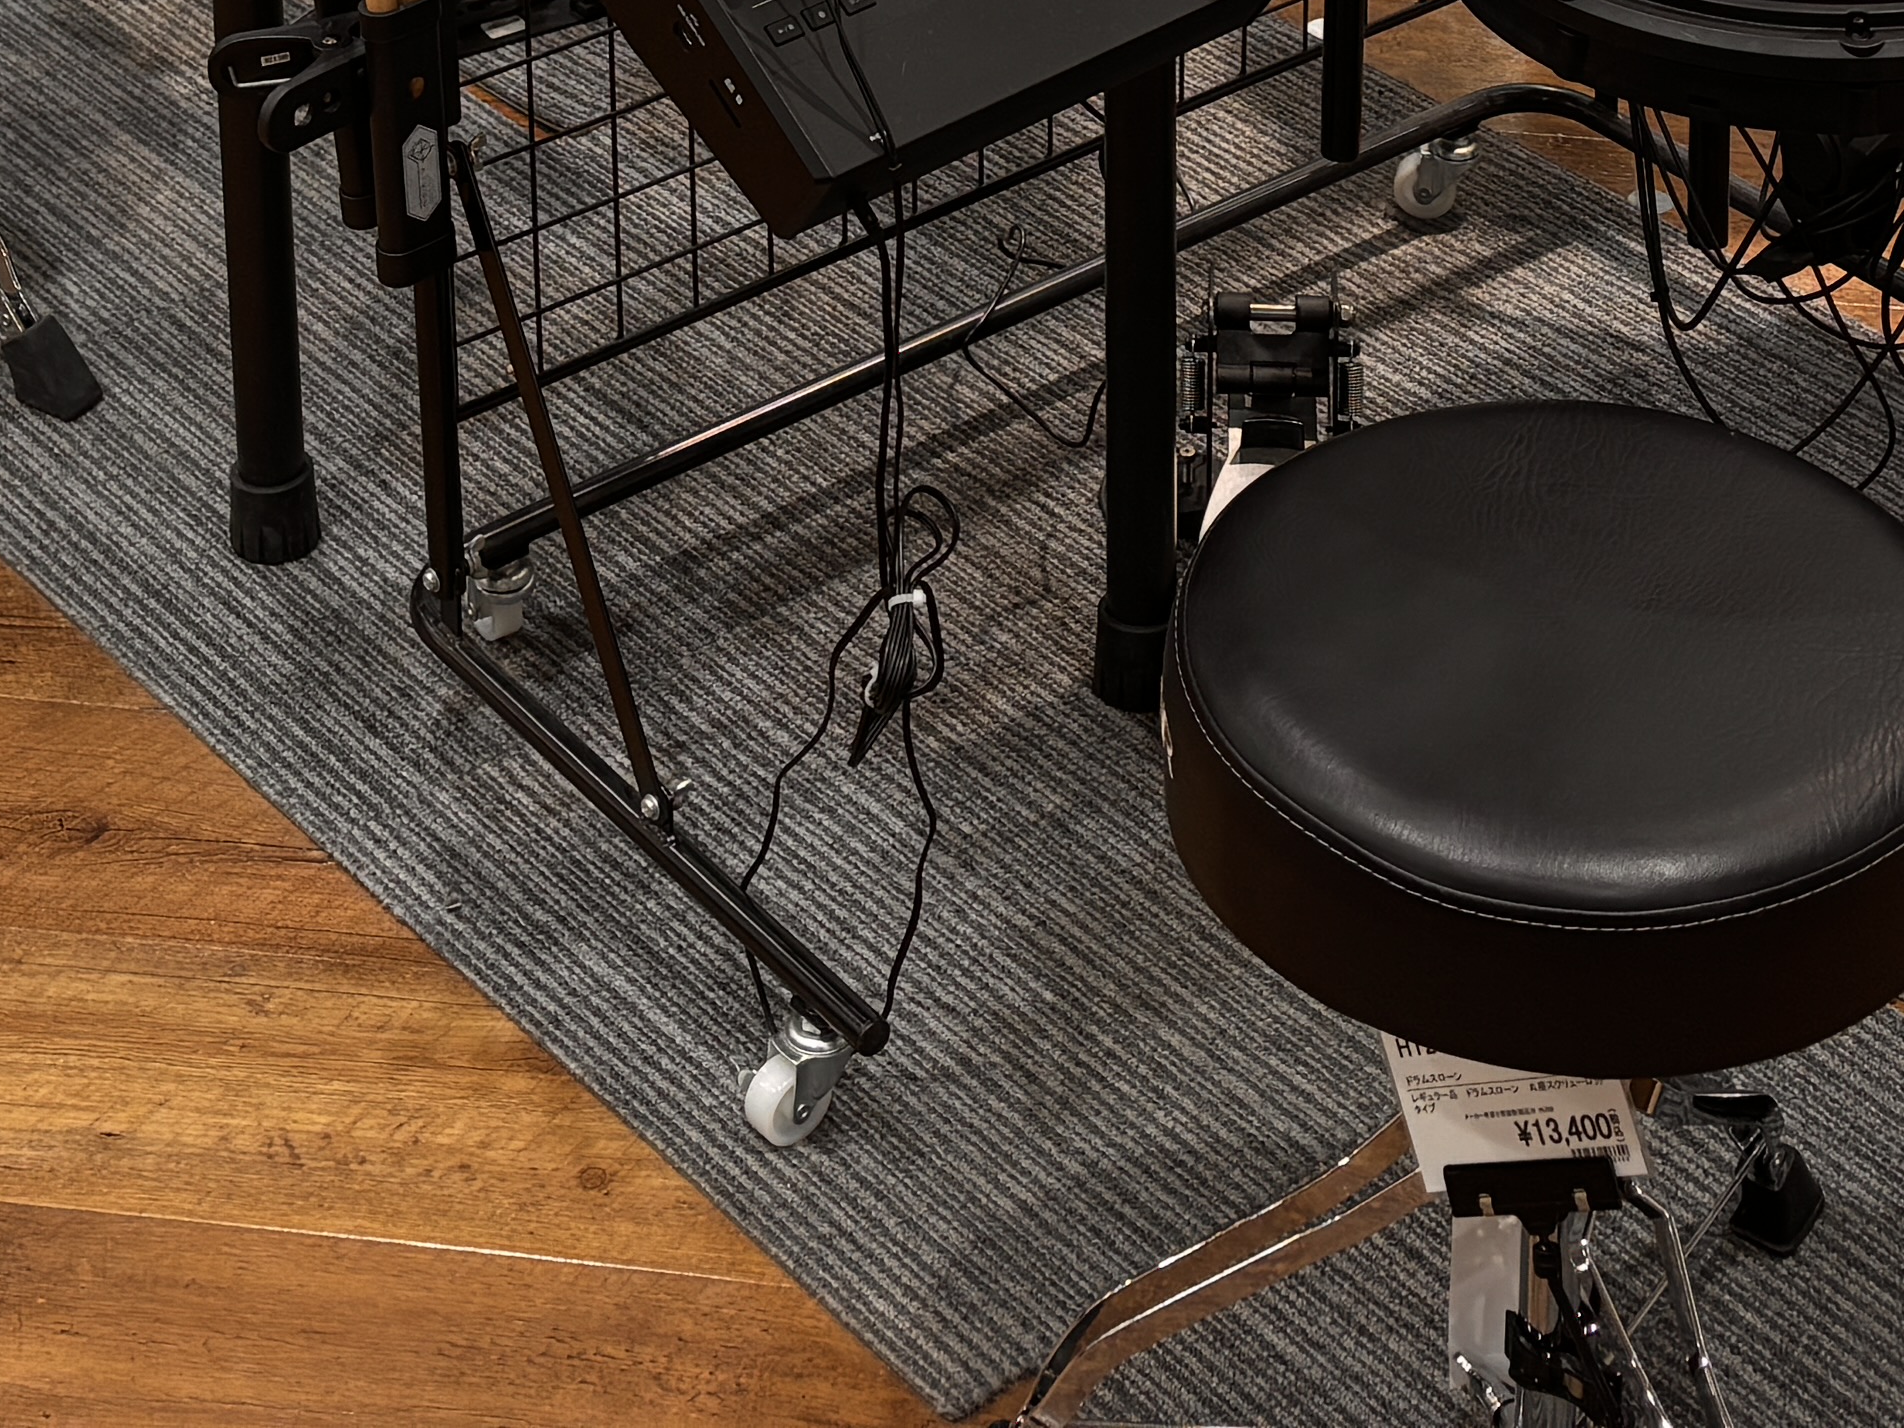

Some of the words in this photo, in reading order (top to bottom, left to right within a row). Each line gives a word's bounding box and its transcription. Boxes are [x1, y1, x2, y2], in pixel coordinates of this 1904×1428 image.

[1406, 1071, 1462, 1087] ドラムスローン
[1465, 1083, 1519, 1099] ドラムスローン
[1514, 1112, 1613, 1148] ¥13,400
